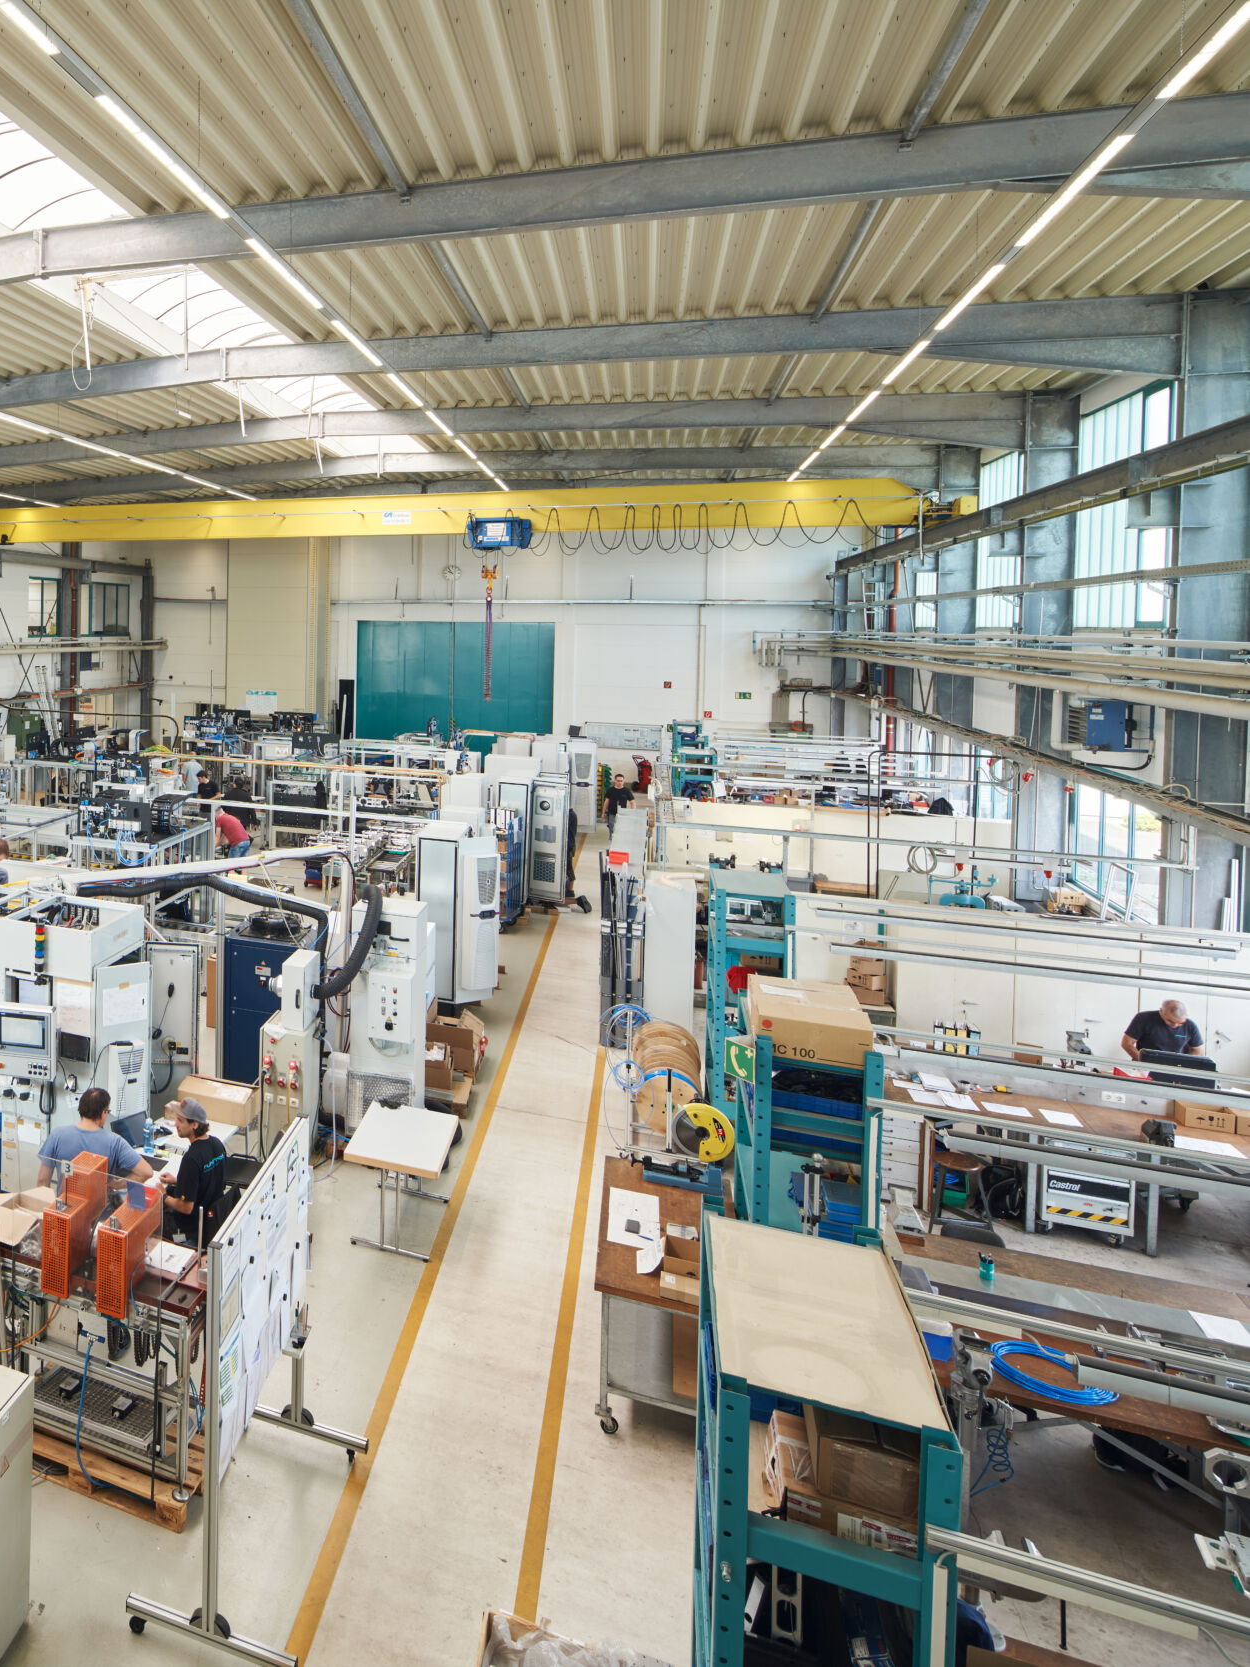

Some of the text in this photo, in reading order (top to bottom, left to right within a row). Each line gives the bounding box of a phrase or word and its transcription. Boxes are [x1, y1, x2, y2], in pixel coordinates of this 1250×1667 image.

[791, 1047, 816, 1059] 100
[64, 1162, 71, 1173] 3
[1049, 1179, 1081, 1192] Castrol
